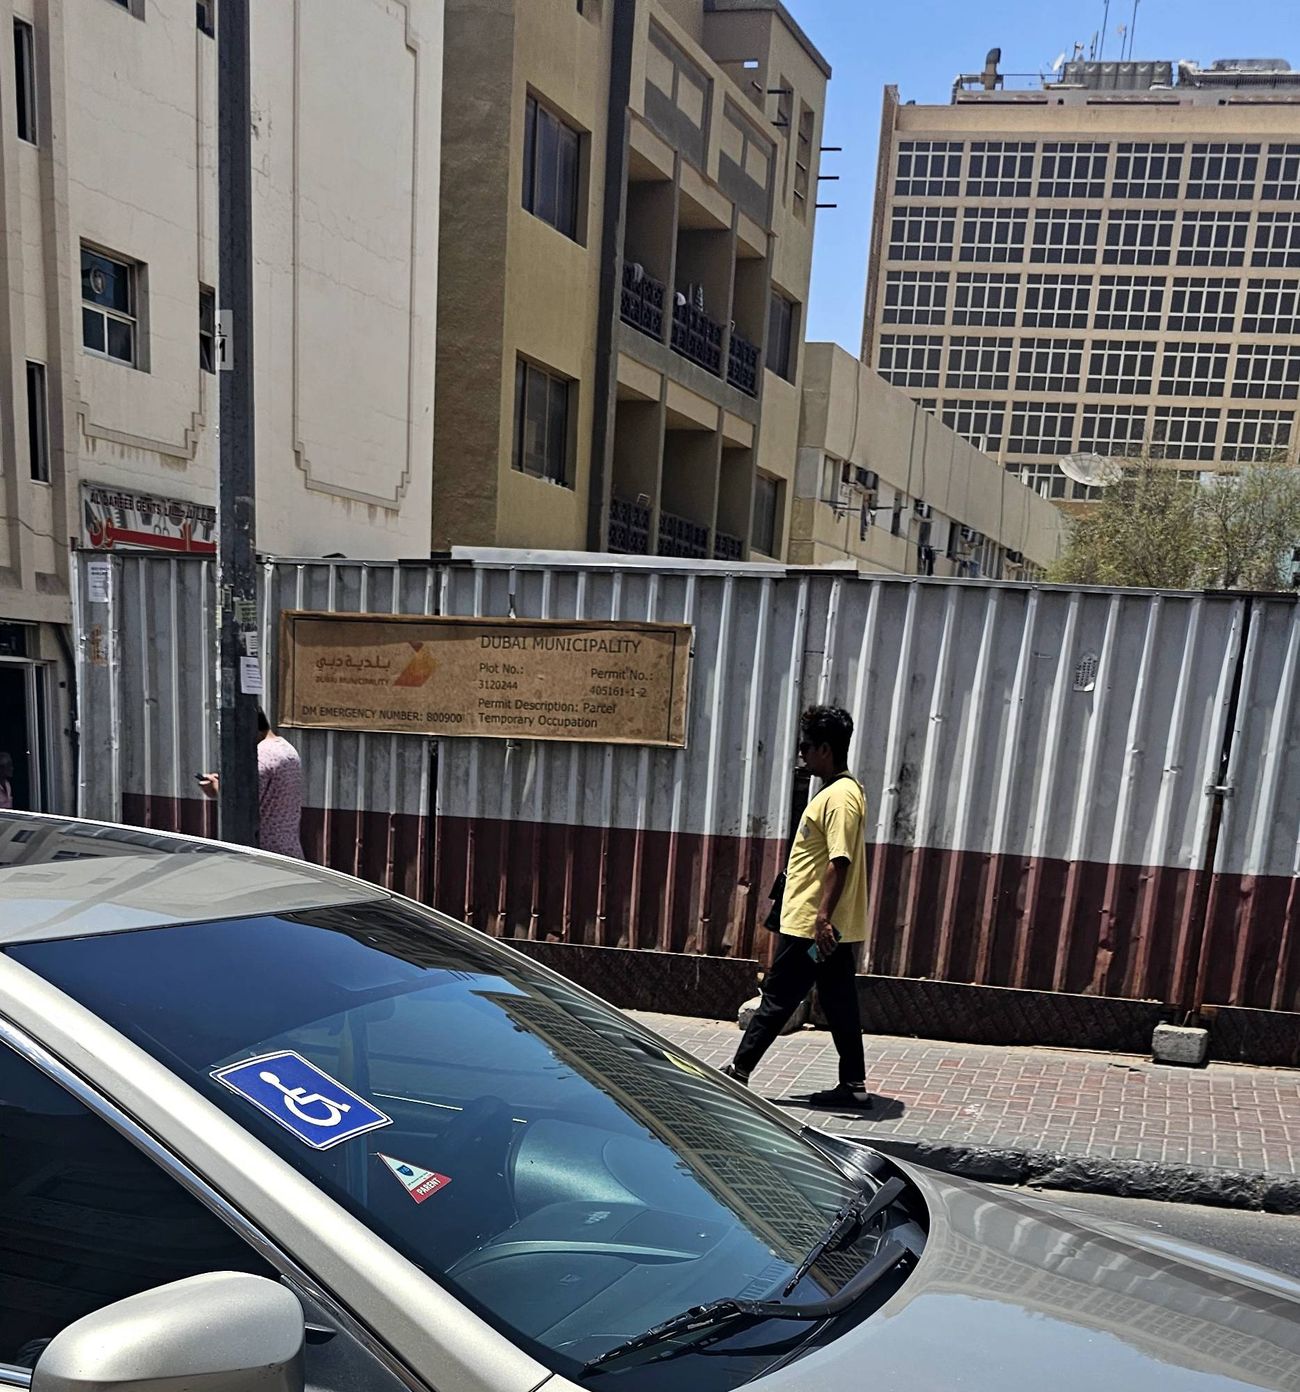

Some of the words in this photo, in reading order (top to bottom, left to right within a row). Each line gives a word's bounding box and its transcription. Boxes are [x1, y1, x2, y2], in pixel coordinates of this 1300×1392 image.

[480, 635, 528, 650] DUBAI
[532, 637, 641, 654] MUNICIPALITY
[315, 657, 343, 672] دبي
[345, 654, 391, 672] بلدية
[479, 663, 499, 674] Plot
[502, 663, 524, 675] No.:
[590, 668, 626, 680] Permit
[629, 669, 654, 681] No.:
[302, 706, 317, 716] DM
[320, 707, 377, 719] EMERGENCY
[379, 710, 423, 722] NUMBER:
[426, 712, 463, 723] 800900
[478, 698, 512, 710] Permit
[514, 699, 579, 714] Description:
[478, 712, 535, 727] Temporary
[538, 715, 598, 729] Occupation
[416, 1177, 441, 1196] PARENT
